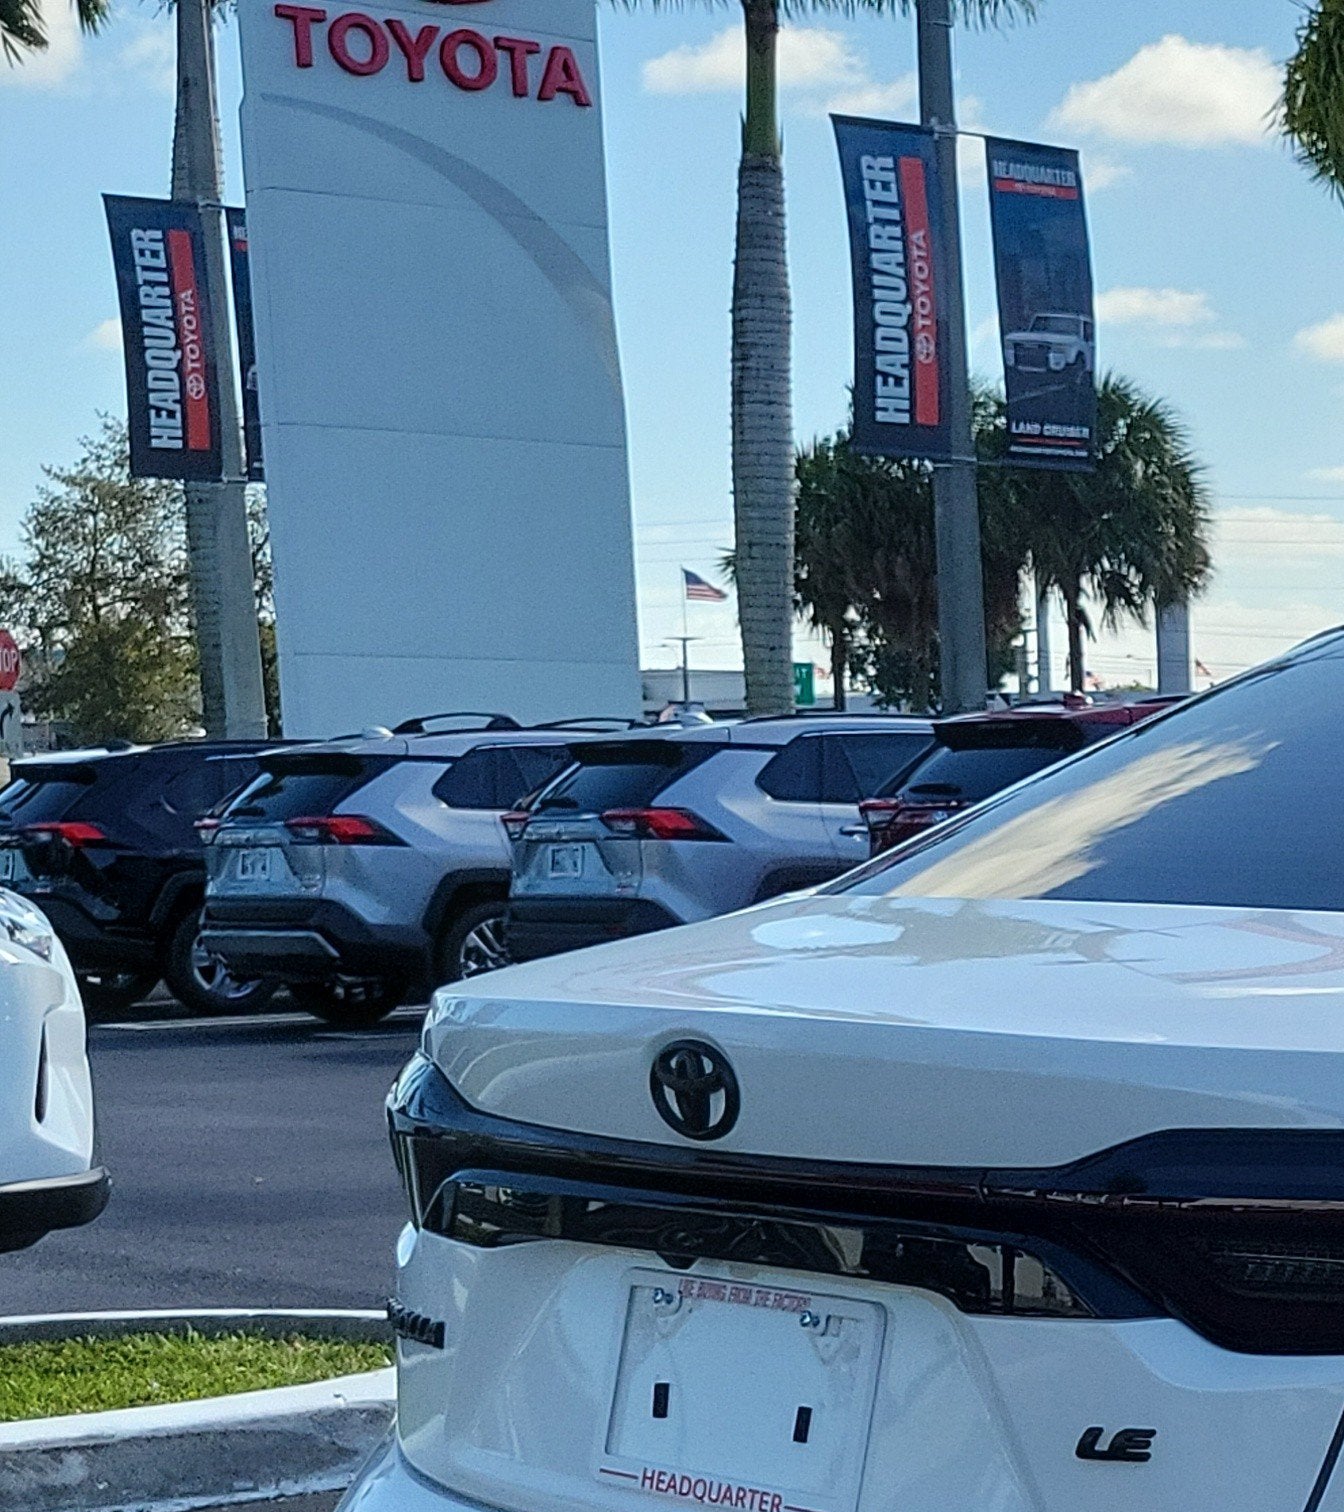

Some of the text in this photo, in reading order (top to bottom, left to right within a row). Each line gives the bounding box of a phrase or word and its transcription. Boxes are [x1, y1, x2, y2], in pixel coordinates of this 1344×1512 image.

[274, 4, 592, 107] TOYOTA
[178, 288, 201, 369] TOYOTA
[860, 154, 911, 425] HEADQUARTER
[910, 230, 935, 331] TOYOTA
[130, 228, 182, 449] HEADQUARTER
[1010, 420, 1041, 435] LAND
[1075, 1426, 1156, 1462] LE
